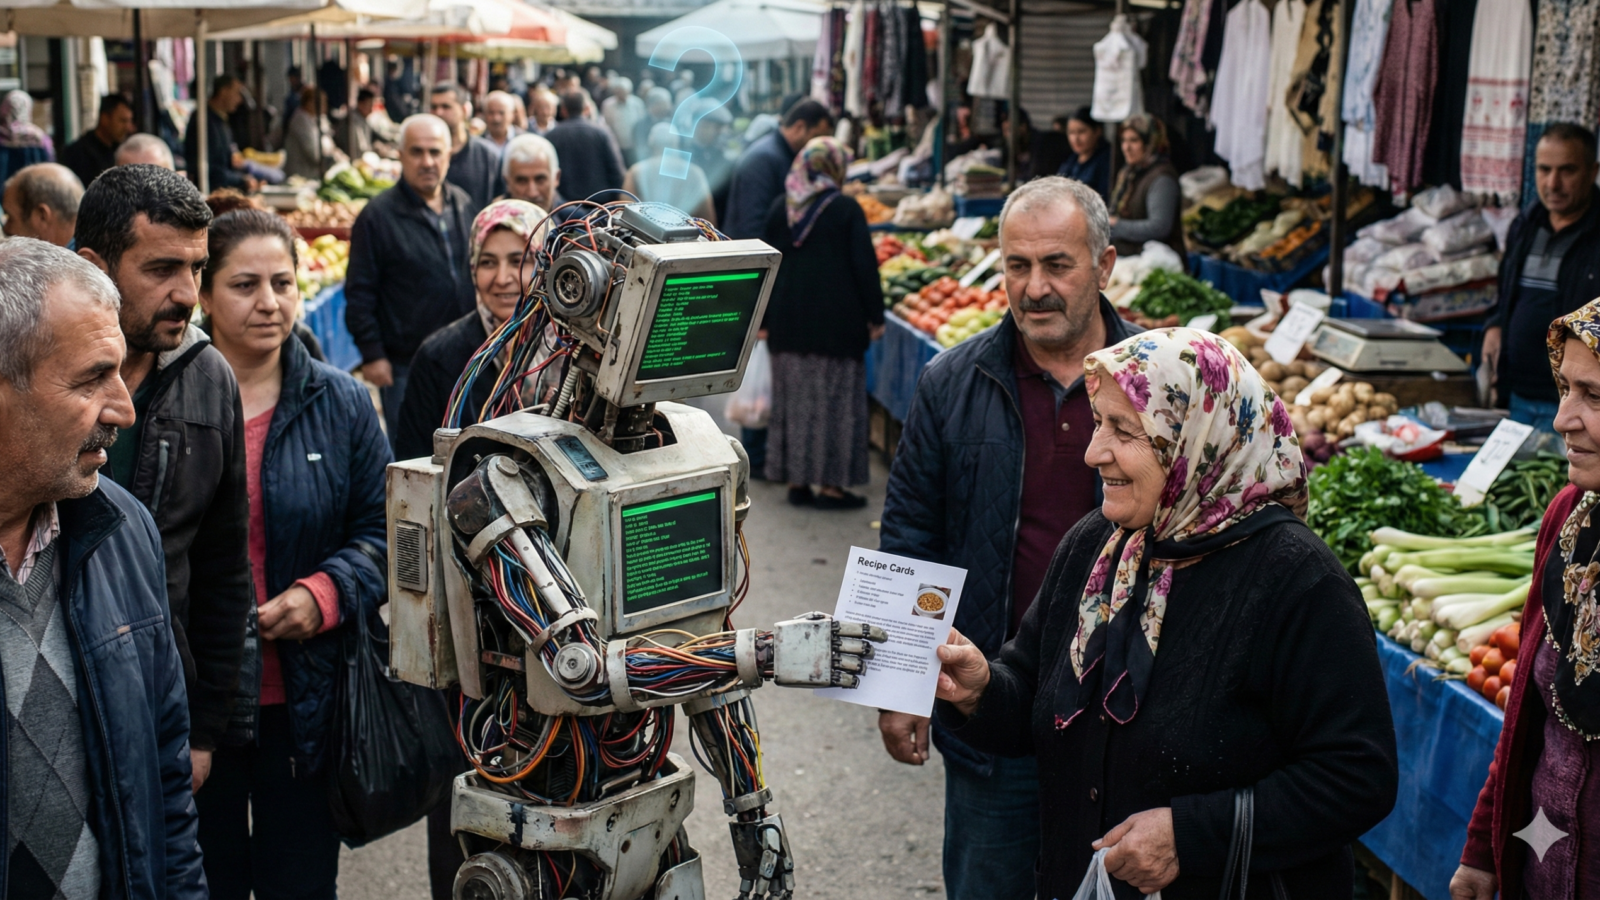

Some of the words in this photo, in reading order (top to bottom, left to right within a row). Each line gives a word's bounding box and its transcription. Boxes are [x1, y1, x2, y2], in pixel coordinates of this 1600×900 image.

[648, 25, 743, 180] ?
[857, 556, 887, 570] Recipe
[889, 563, 915, 575] Cards
